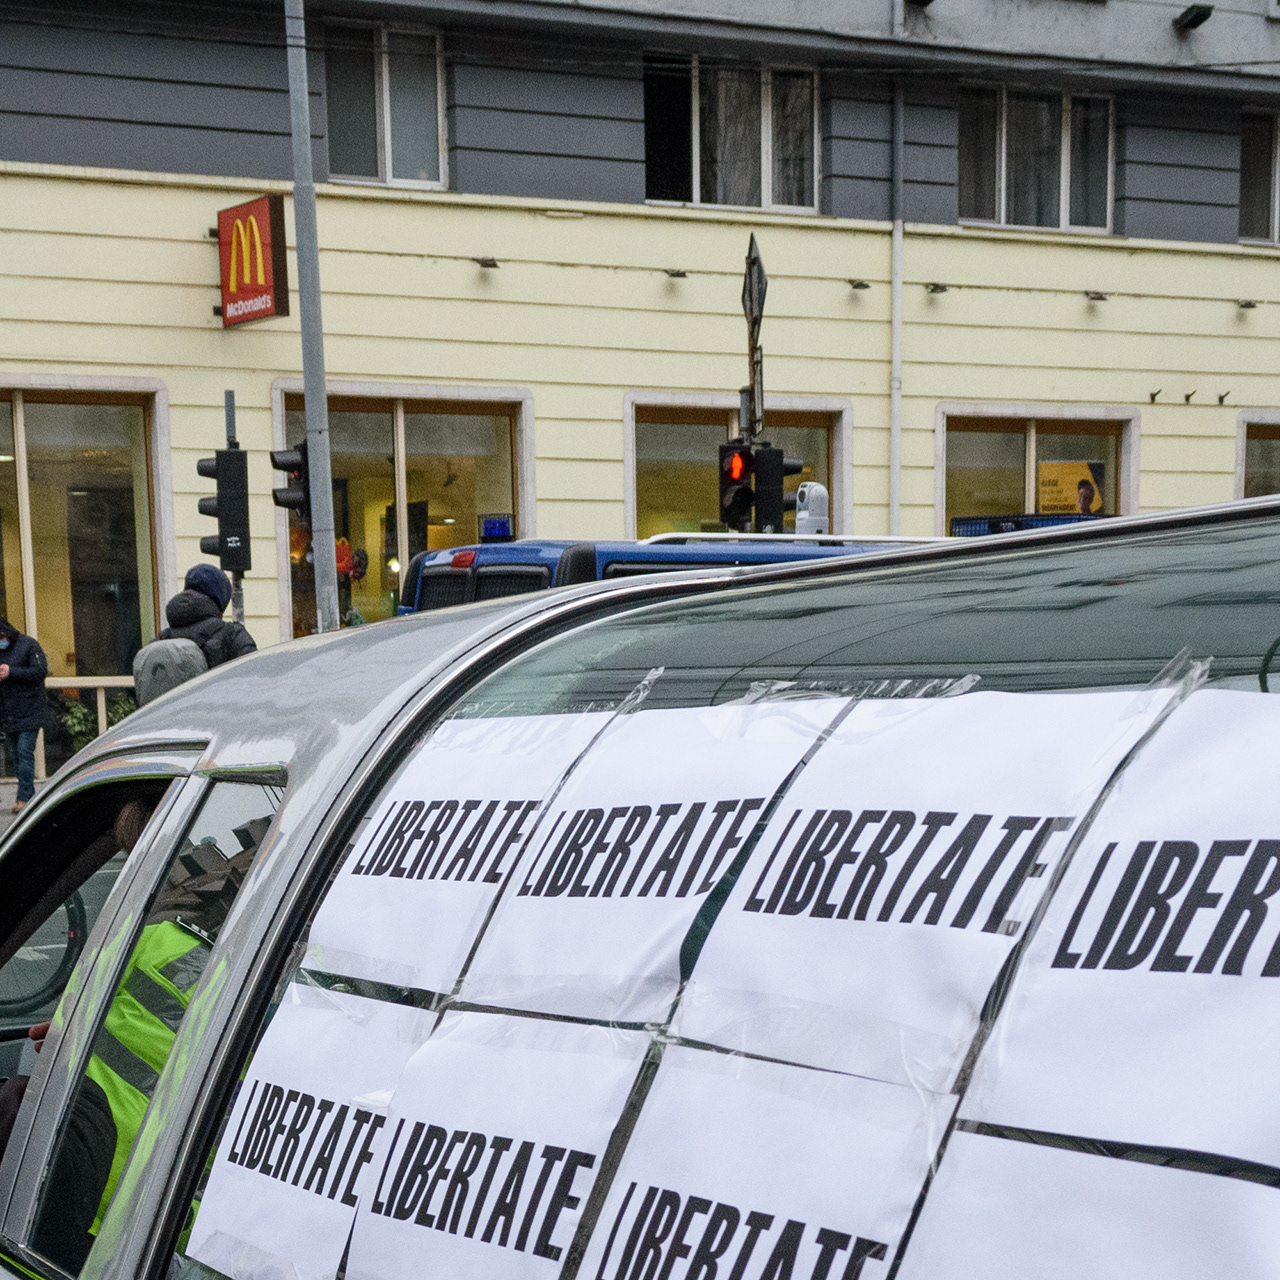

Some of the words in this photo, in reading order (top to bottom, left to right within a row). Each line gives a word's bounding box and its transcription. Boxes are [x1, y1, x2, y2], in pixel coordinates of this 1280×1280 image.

[227, 294, 272, 318] McDonald's
[351, 799, 542, 884] LIBERTATE
[517, 798, 766, 898] LIBERTATE
[743, 808, 1076, 935] LIBERTATE
[228, 1080, 386, 1208] LIBERTATE
[372, 1118, 595, 1261] LIBERTATE
